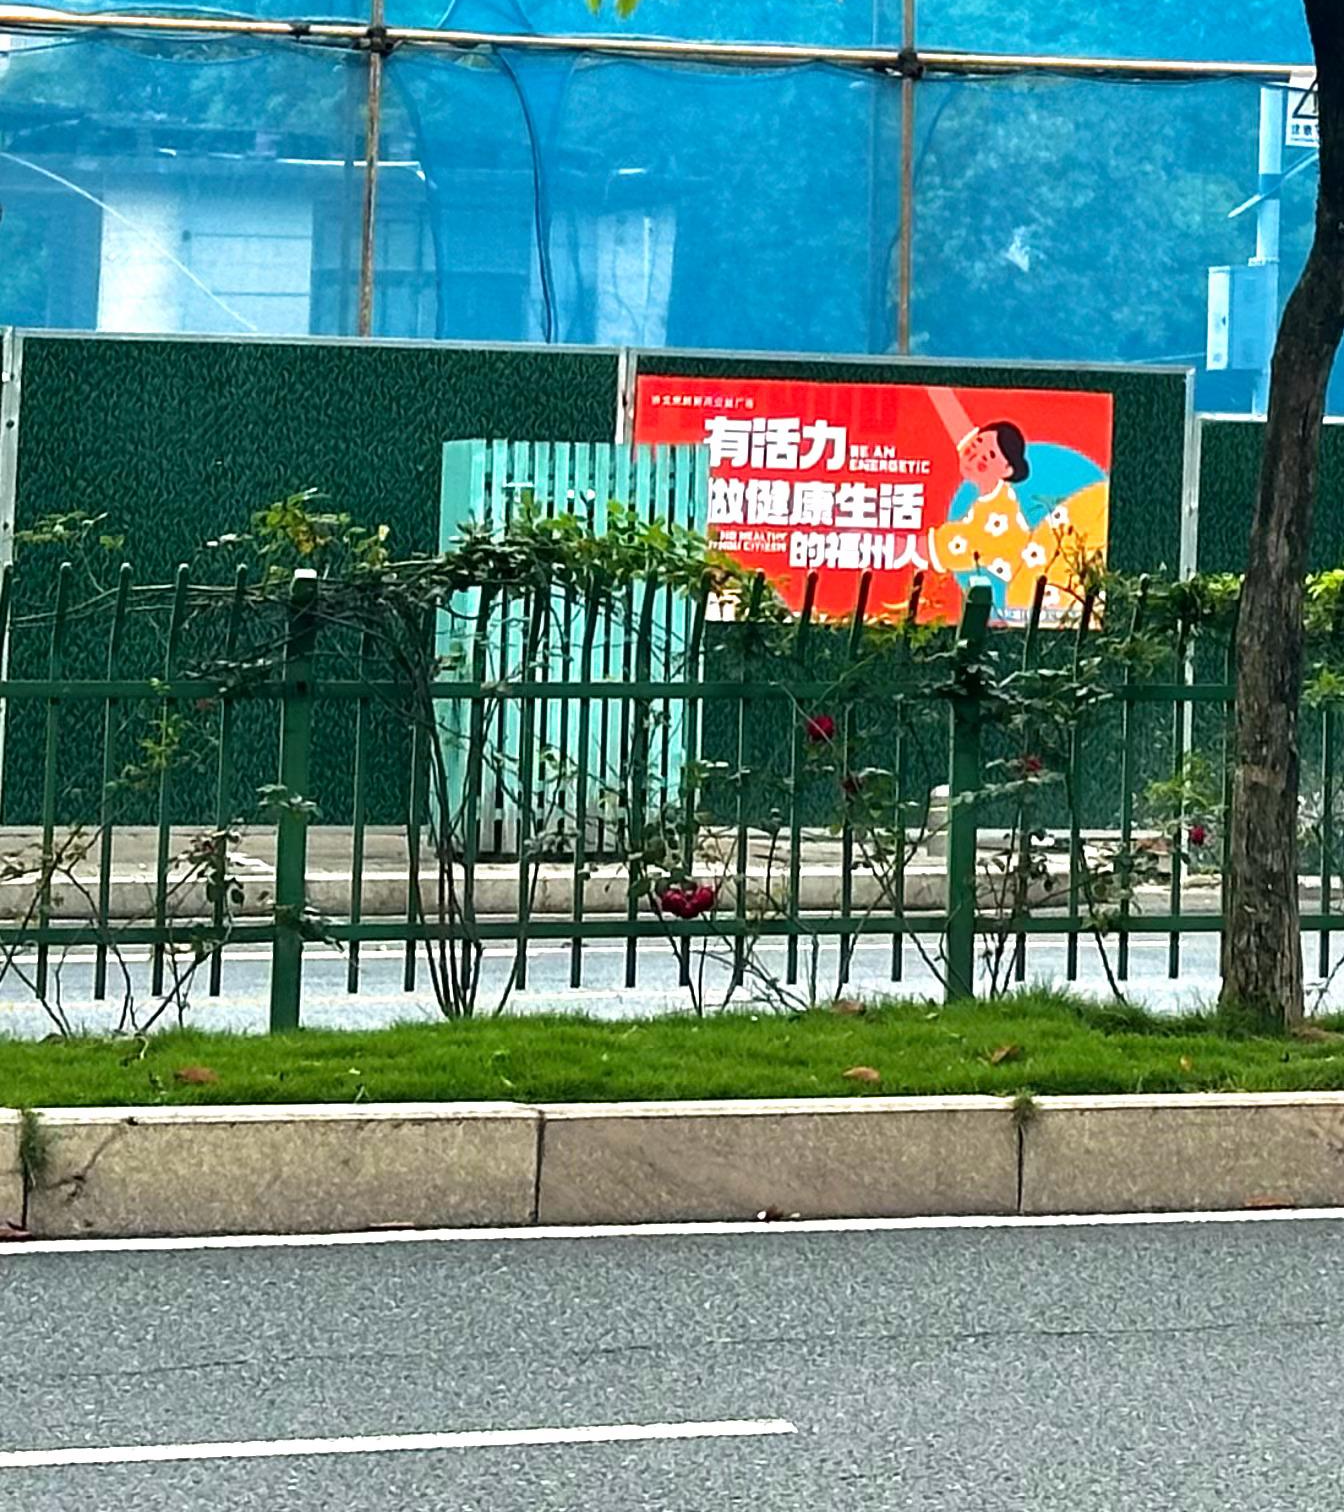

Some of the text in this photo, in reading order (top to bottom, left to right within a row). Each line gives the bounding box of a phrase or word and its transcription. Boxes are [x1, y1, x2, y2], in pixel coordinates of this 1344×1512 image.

[704, 416, 847, 470] 有活力
[708, 476, 925, 529] 做健康生活
[789, 531, 929, 570] 的福州人
